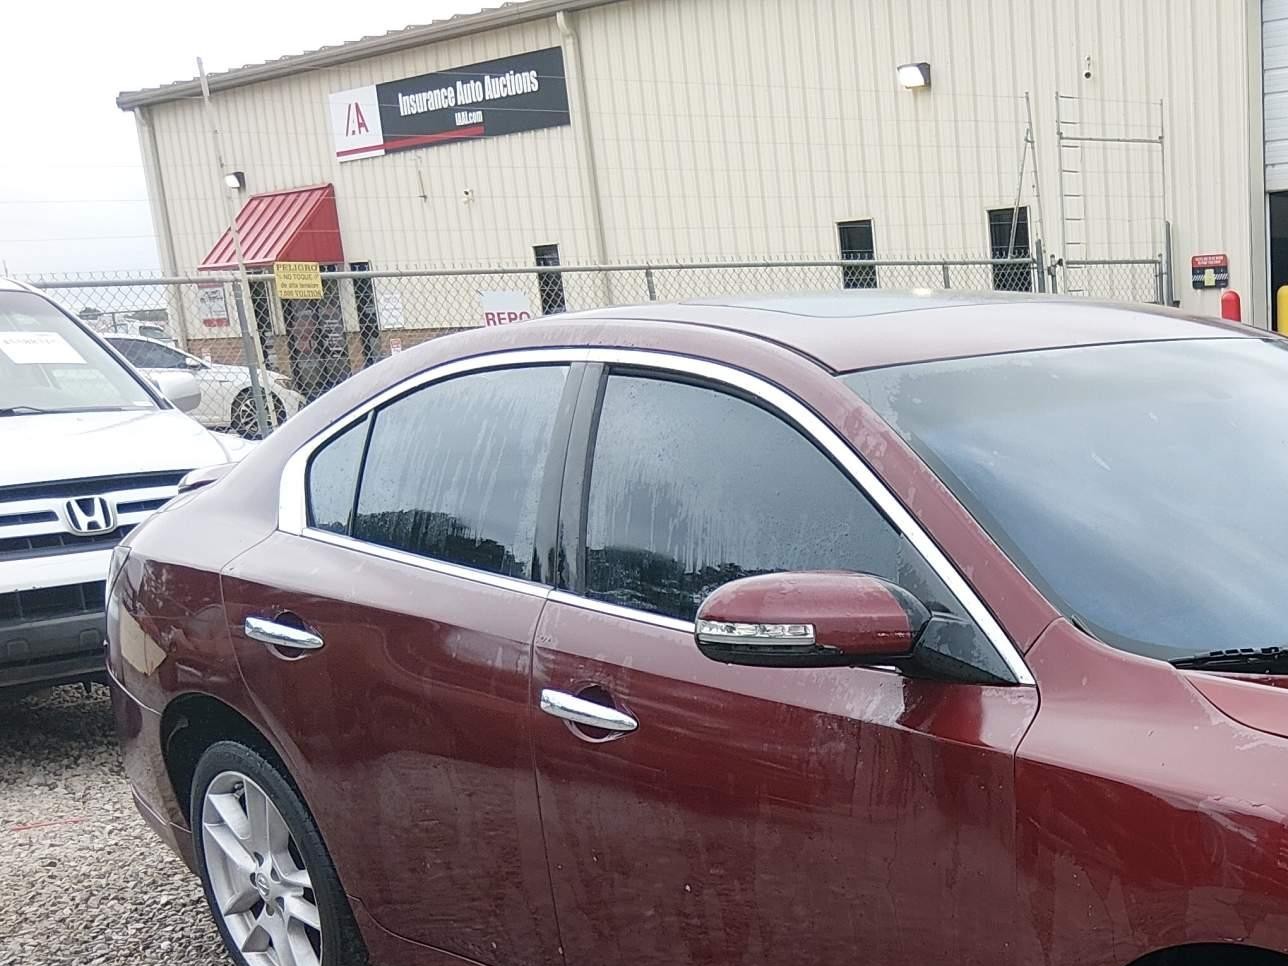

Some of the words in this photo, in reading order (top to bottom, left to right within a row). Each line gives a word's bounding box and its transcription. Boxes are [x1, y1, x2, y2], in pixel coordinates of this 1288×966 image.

[398, 86, 455, 116] Insurance
[456, 80, 484, 106] Auto
[484, 70, 539, 101] Auctions
[485, 311, 531, 326] REPO
